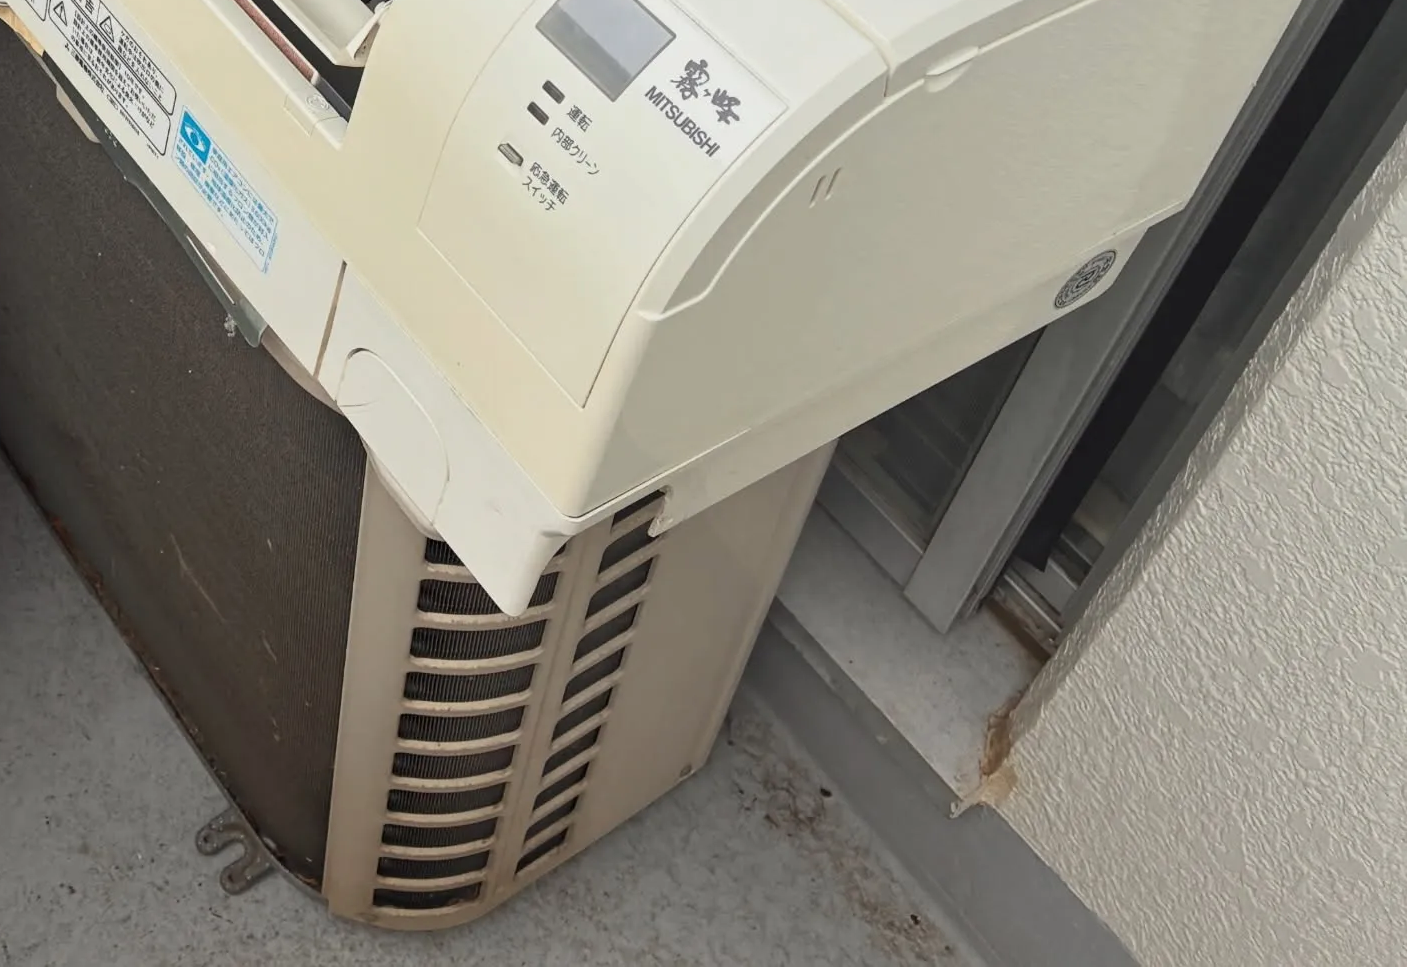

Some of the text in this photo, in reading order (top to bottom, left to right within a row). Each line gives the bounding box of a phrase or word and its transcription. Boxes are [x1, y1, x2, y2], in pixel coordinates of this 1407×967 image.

[670, 59, 741, 127] 霧ヶ峰
[566, 105, 594, 133] 運転
[645, 86, 720, 158] MITSUBISHI
[550, 127, 600, 177] 内部クリーン
[522, 177, 557, 212] スイッチ
[529, 161, 571, 205] 応急運転
